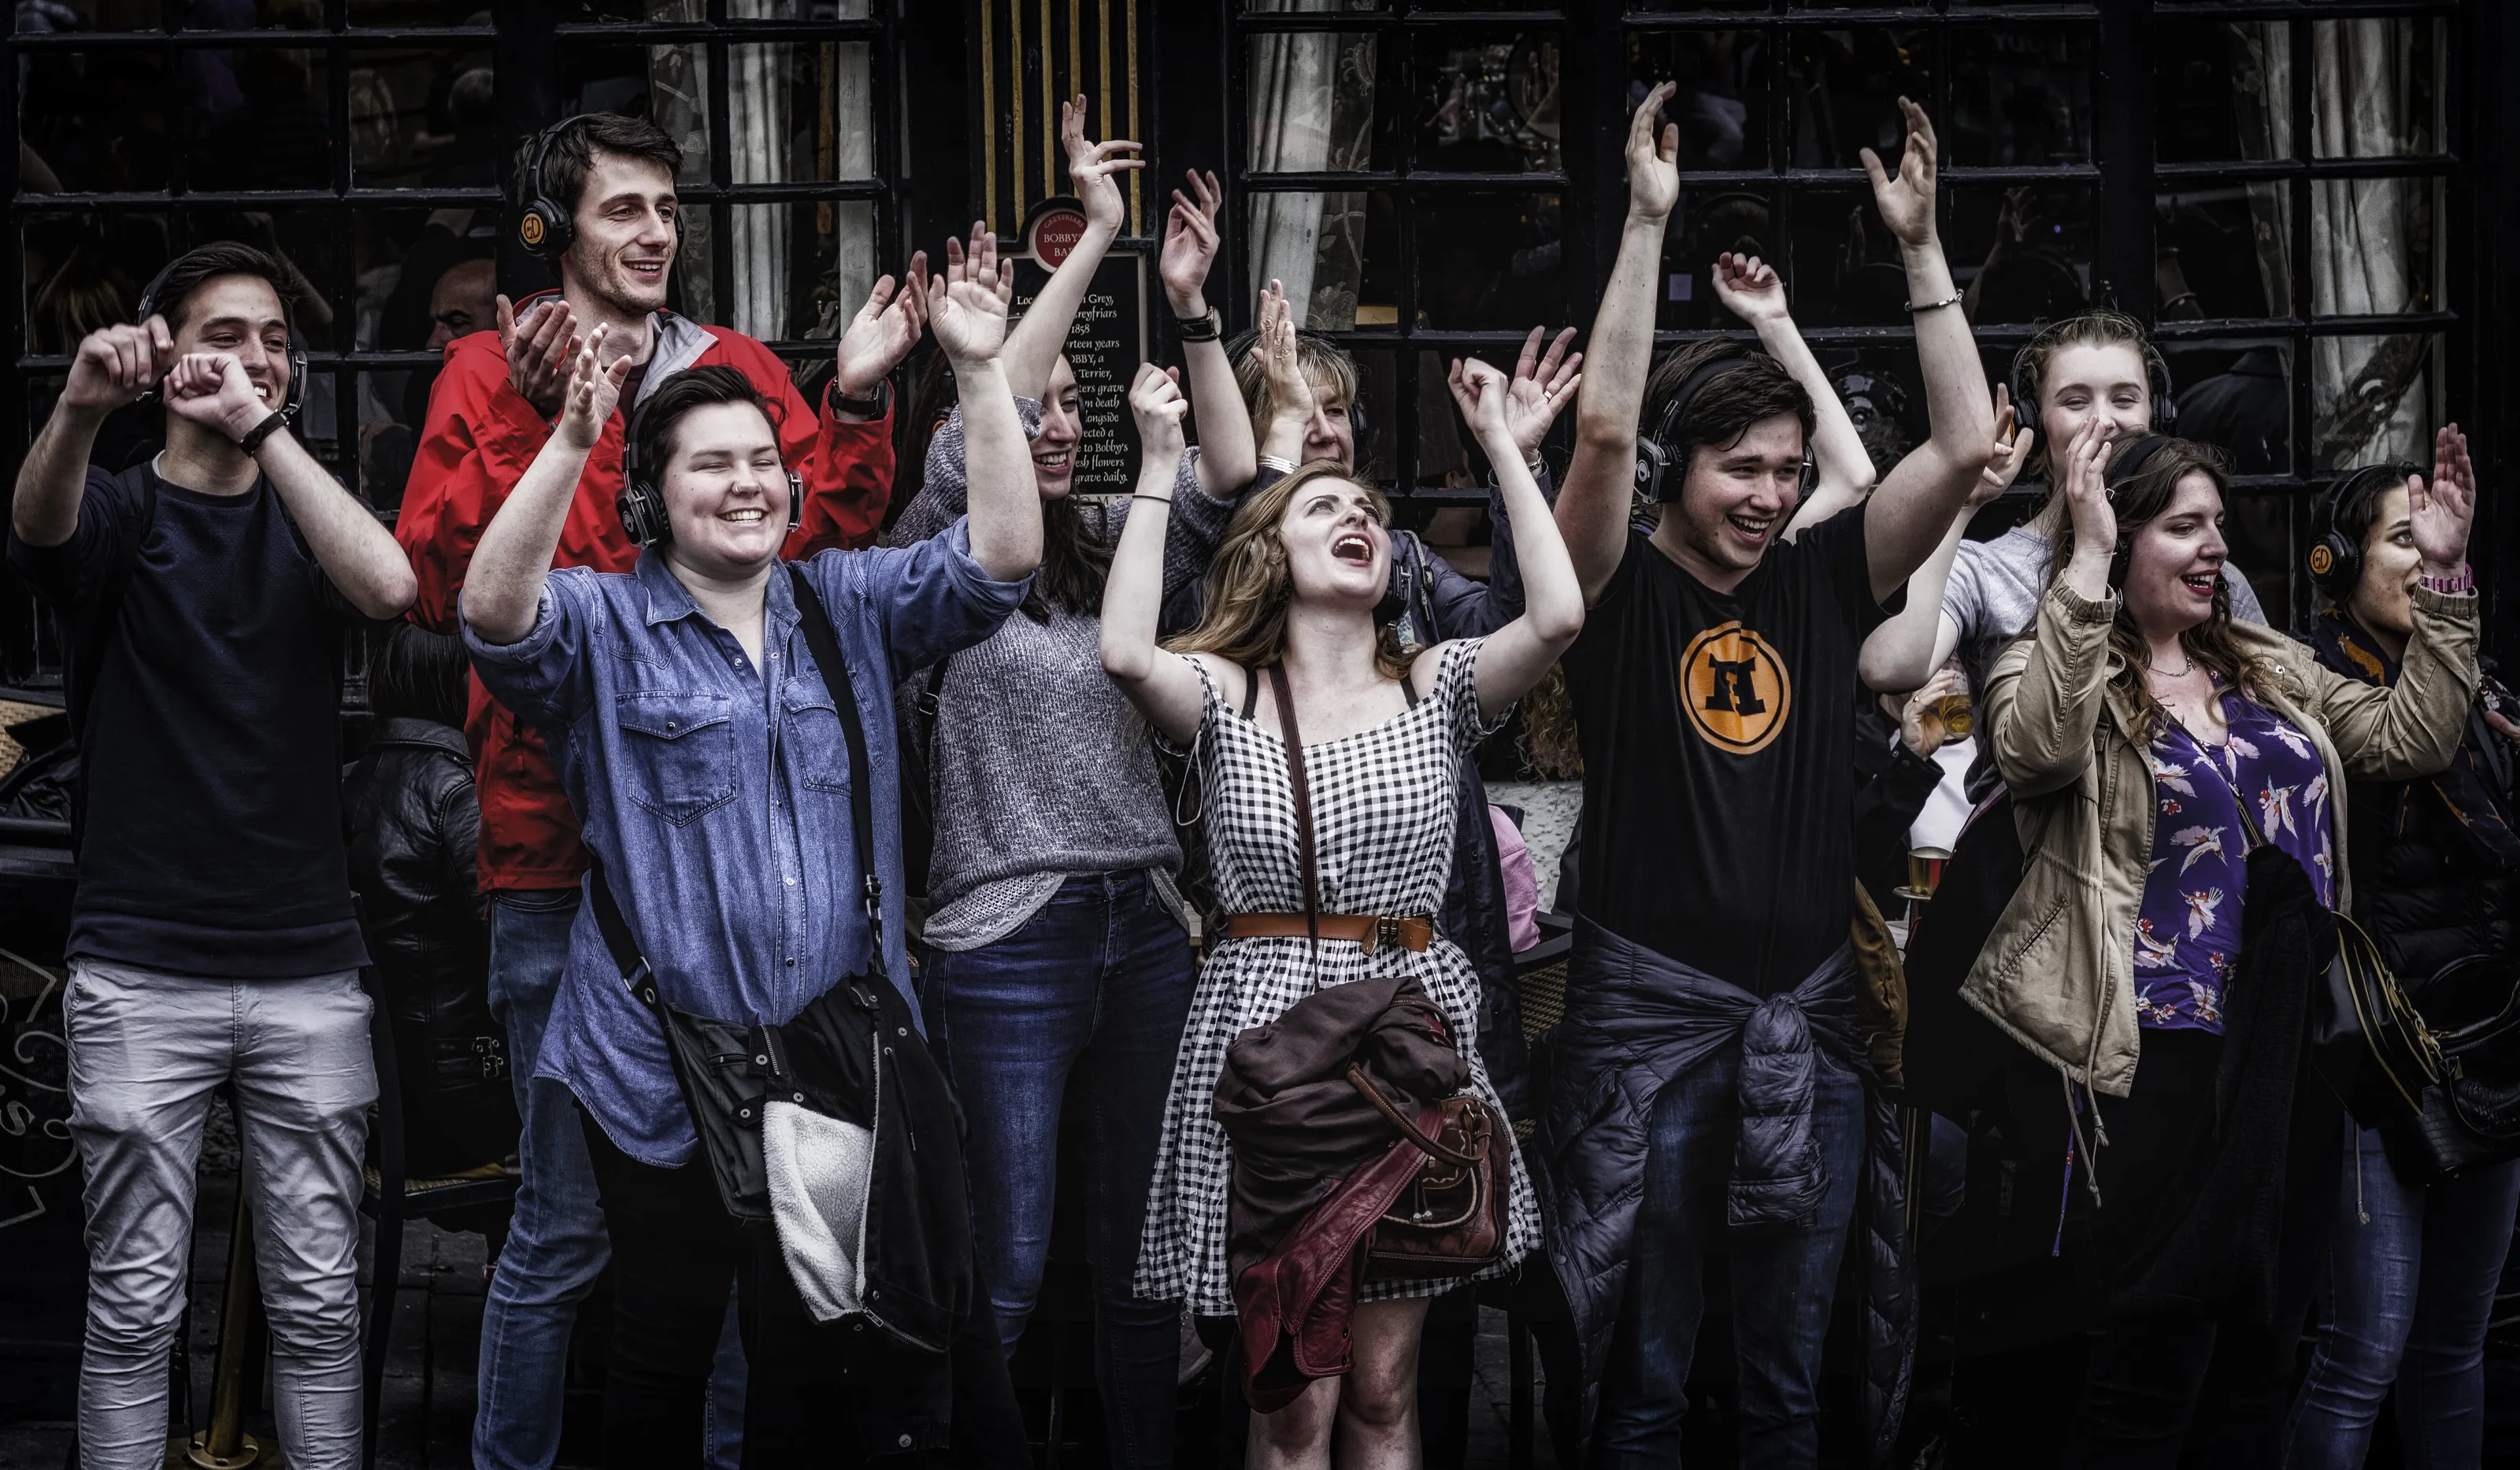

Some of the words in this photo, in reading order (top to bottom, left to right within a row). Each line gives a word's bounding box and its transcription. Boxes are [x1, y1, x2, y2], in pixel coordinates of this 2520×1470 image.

[1043, 214, 1084, 228] GREYFRIARS
[1043, 233, 1083, 243] BOBBY'
[1017, 296, 1033, 305] Loc
[1088, 294, 1114, 306] Grey,
[1076, 305, 1117, 321] reyfriars
[1071, 324, 1090, 335] 1858
[1067, 339, 1092, 348] rteen
[1095, 339, 1120, 351] years
[1078, 367, 1112, 381] Terrier,
[1079, 384, 1095, 393] ters
[1097, 384, 1125, 396] grave
[1095, 394, 1119, 409] death
[1085, 410, 1119, 425] longside
[1082, 427, 1106, 438] ected
[1084, 443, 1093, 453] to
[1095, 439, 1128, 455] Bobby's
[1075, 454, 1089, 469] esh
[1091, 454, 1125, 470] flowers
[1075, 474, 1101, 485] grave
[1103, 468, 1128, 484] daily.
